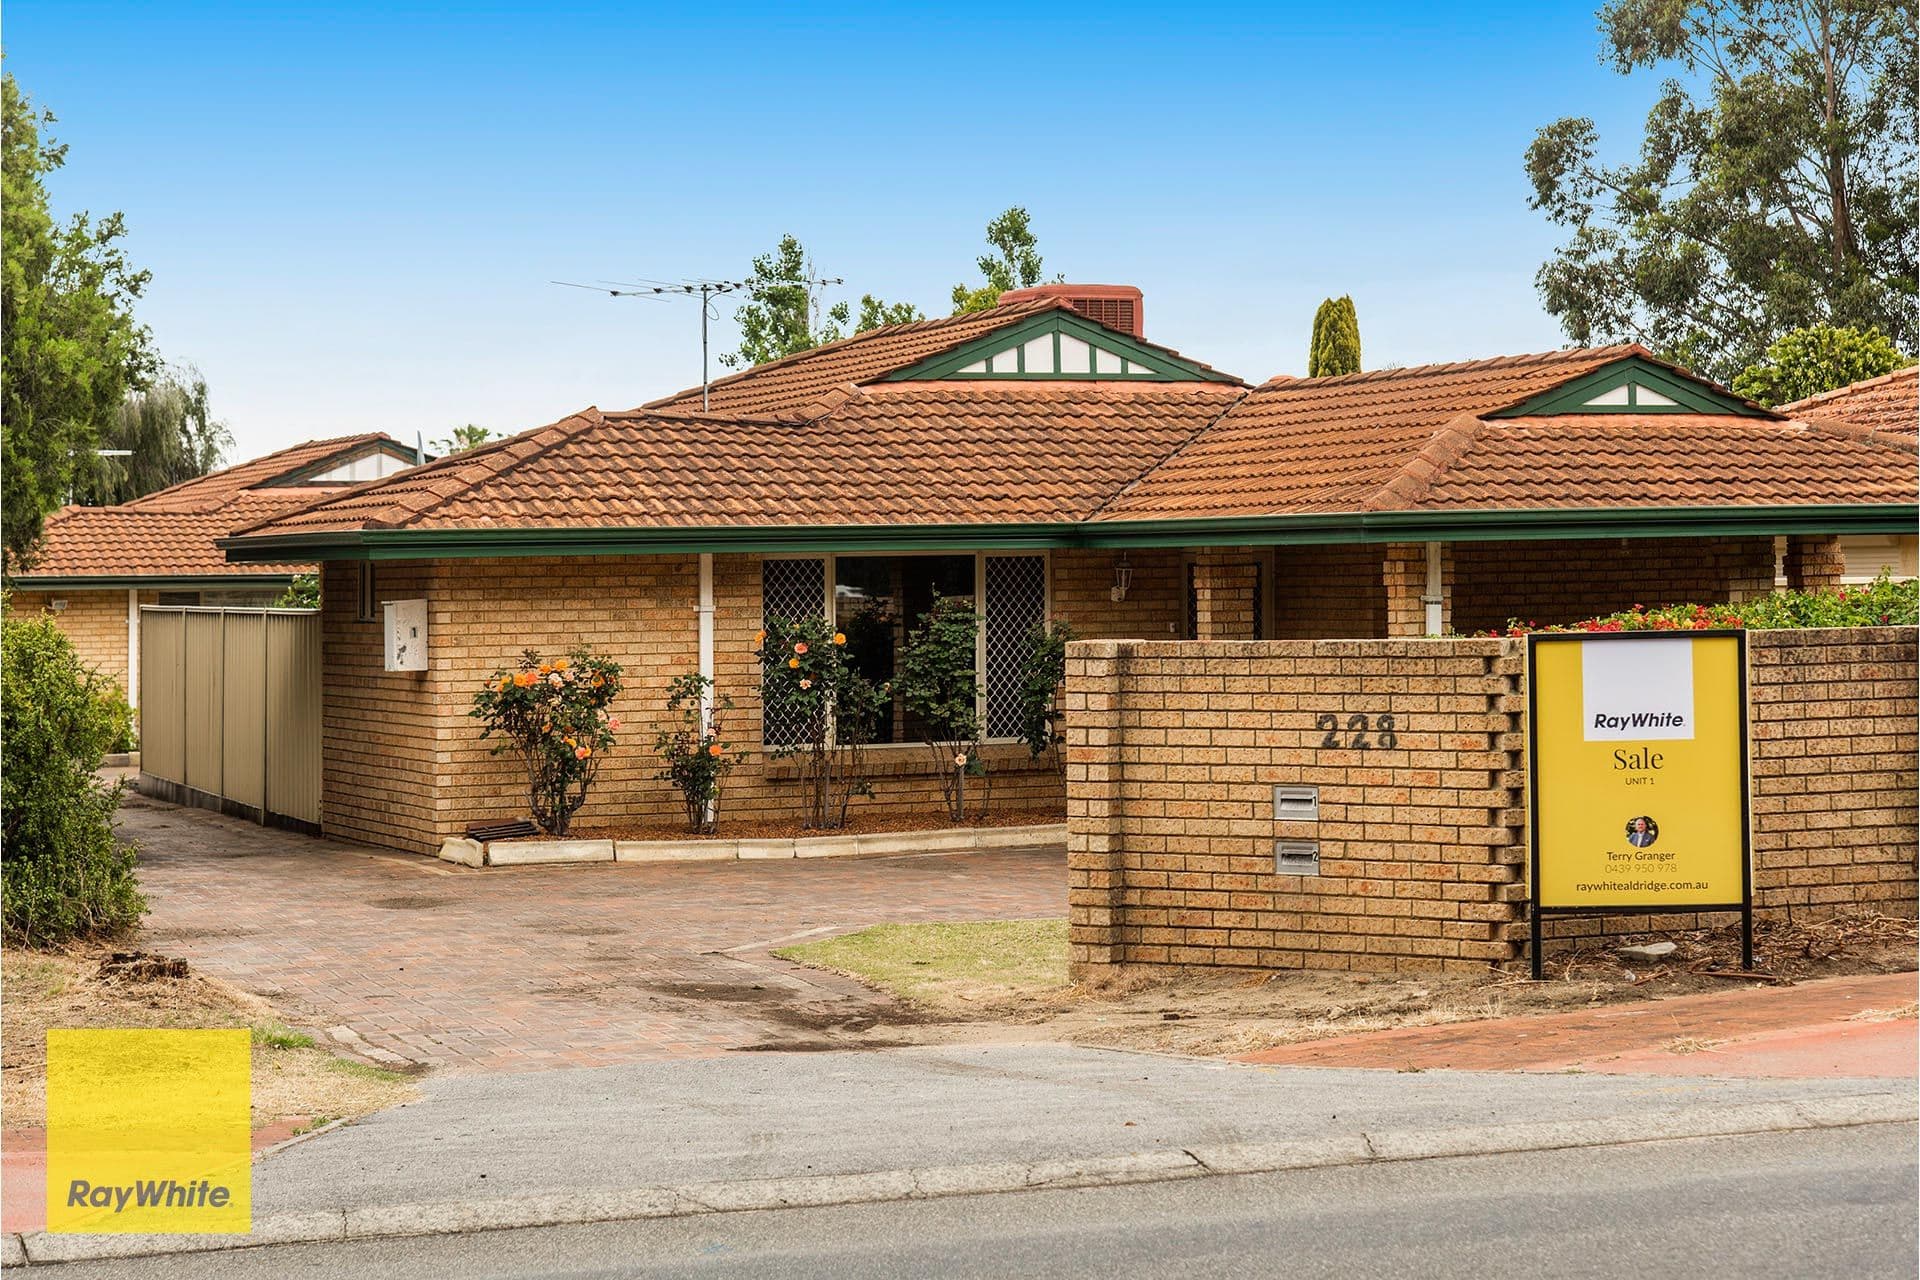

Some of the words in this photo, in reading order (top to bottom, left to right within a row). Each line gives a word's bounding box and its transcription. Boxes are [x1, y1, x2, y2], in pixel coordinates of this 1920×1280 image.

[1317, 713, 1398, 750] 228
[1613, 747, 1664, 771] Sale
[1625, 777, 1648, 786] UNIT
[1312, 851, 1319, 863] 2
[1606, 851, 1632, 862] Terry
[1634, 851, 1676, 862] Granger
[1604, 864, 1632, 874] 0439
[1633, 864, 1655, 873] 950
[1656, 863, 1677, 873] 978
[1576, 880, 1709, 892] raywhitealdridge.com.au
